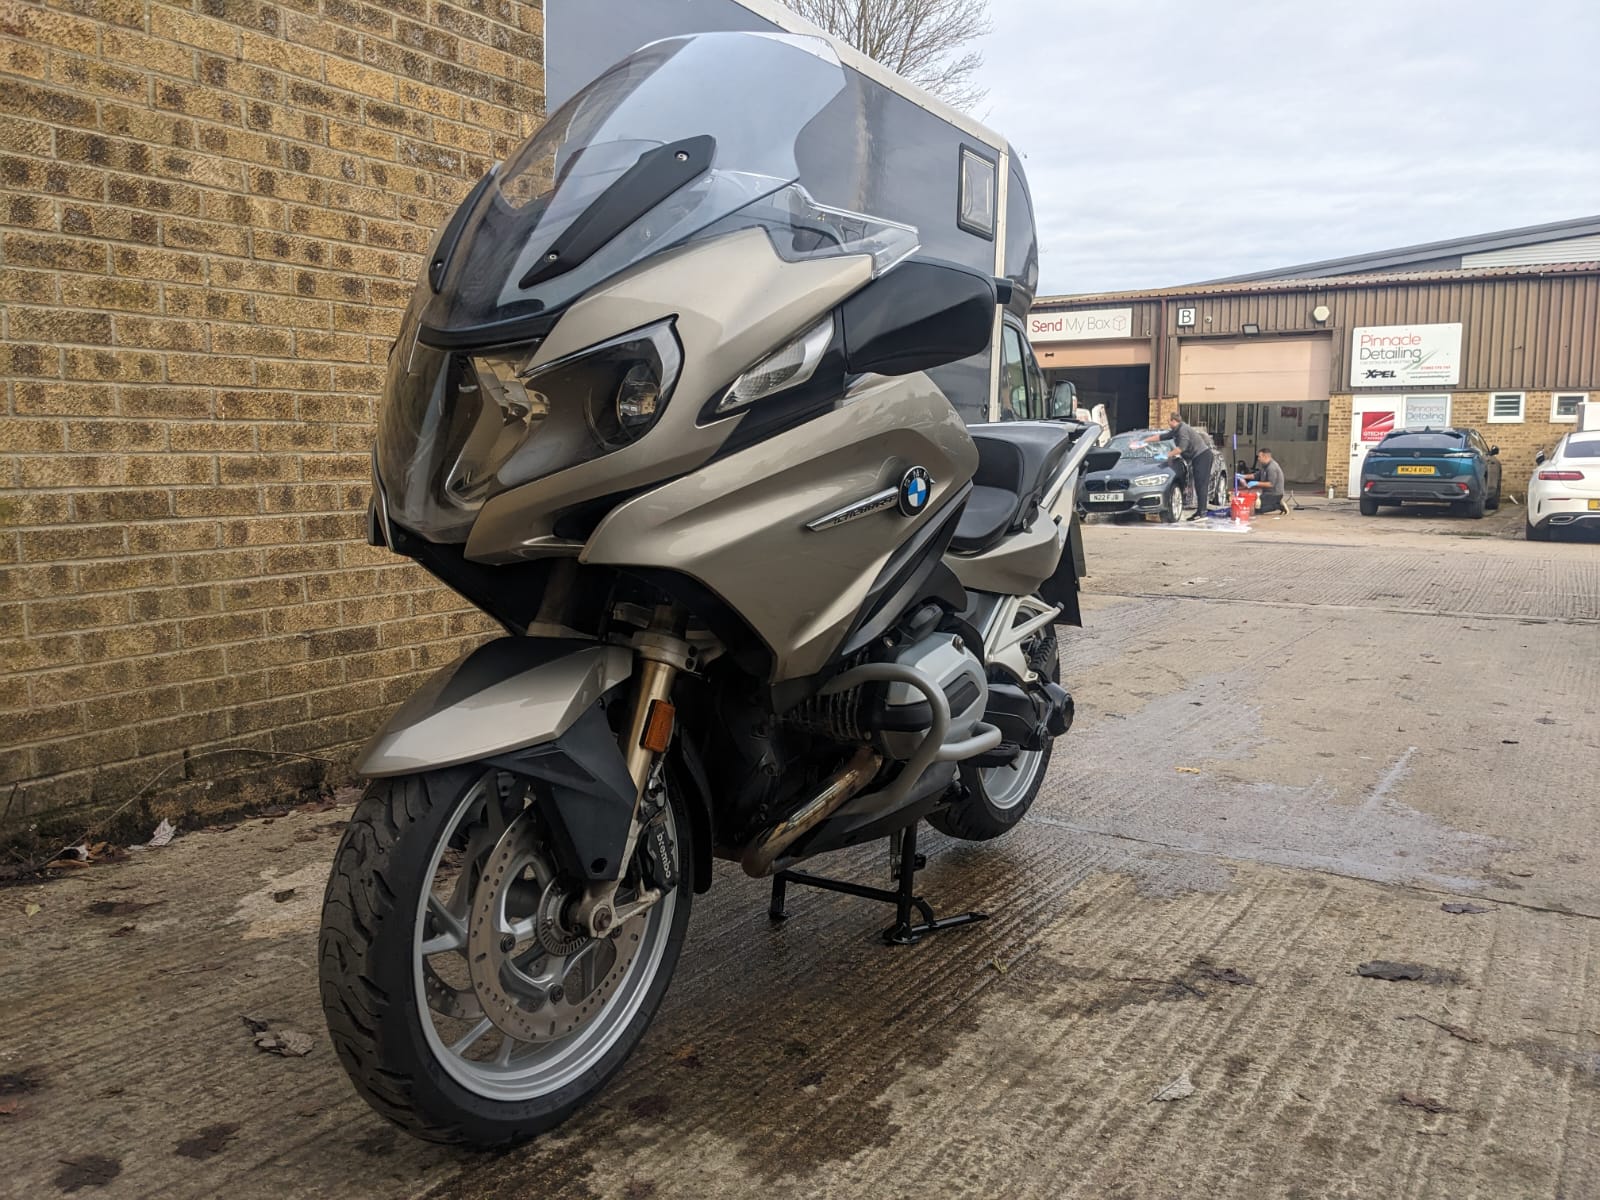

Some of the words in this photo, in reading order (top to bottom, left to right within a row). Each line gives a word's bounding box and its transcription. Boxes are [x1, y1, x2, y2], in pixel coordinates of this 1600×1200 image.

[1182, 310, 1192, 323] B
[1031, 318, 1063, 333] Send
[1065, 317, 1086, 334] My
[1087, 316, 1111, 330] Box
[1360, 333, 1422, 347] Pinnacle
[1360, 346, 1422, 364] Detailing
[1365, 370, 1397, 379] XPEL
[656, 831, 671, 878] brembo
